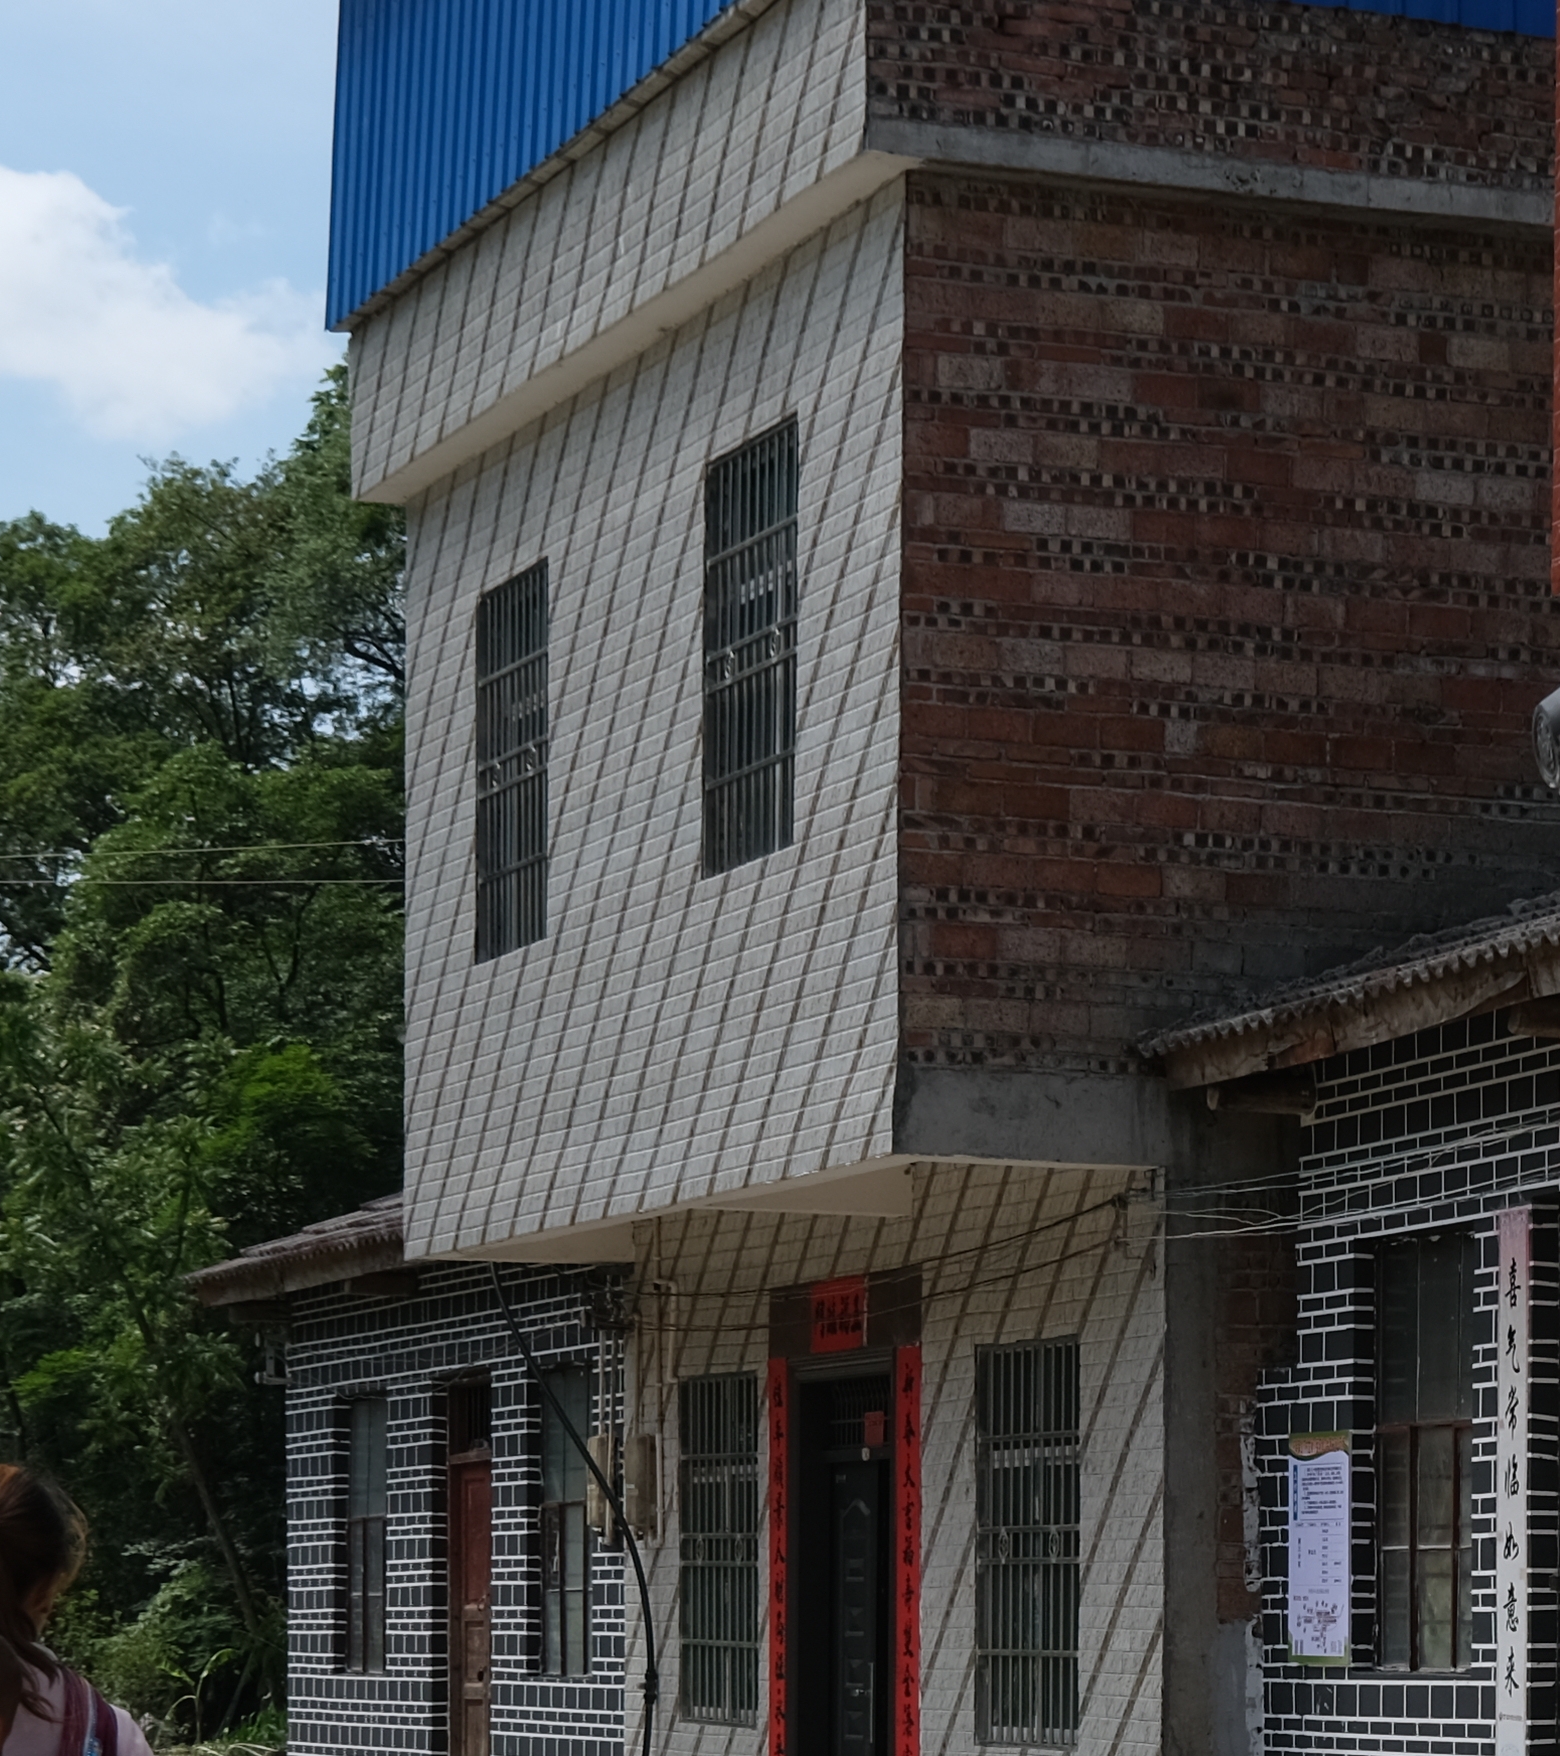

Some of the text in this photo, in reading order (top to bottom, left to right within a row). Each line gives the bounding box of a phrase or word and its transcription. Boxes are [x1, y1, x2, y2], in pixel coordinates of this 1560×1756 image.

[1503, 1257, 1522, 1698] 喜气常临如意来
